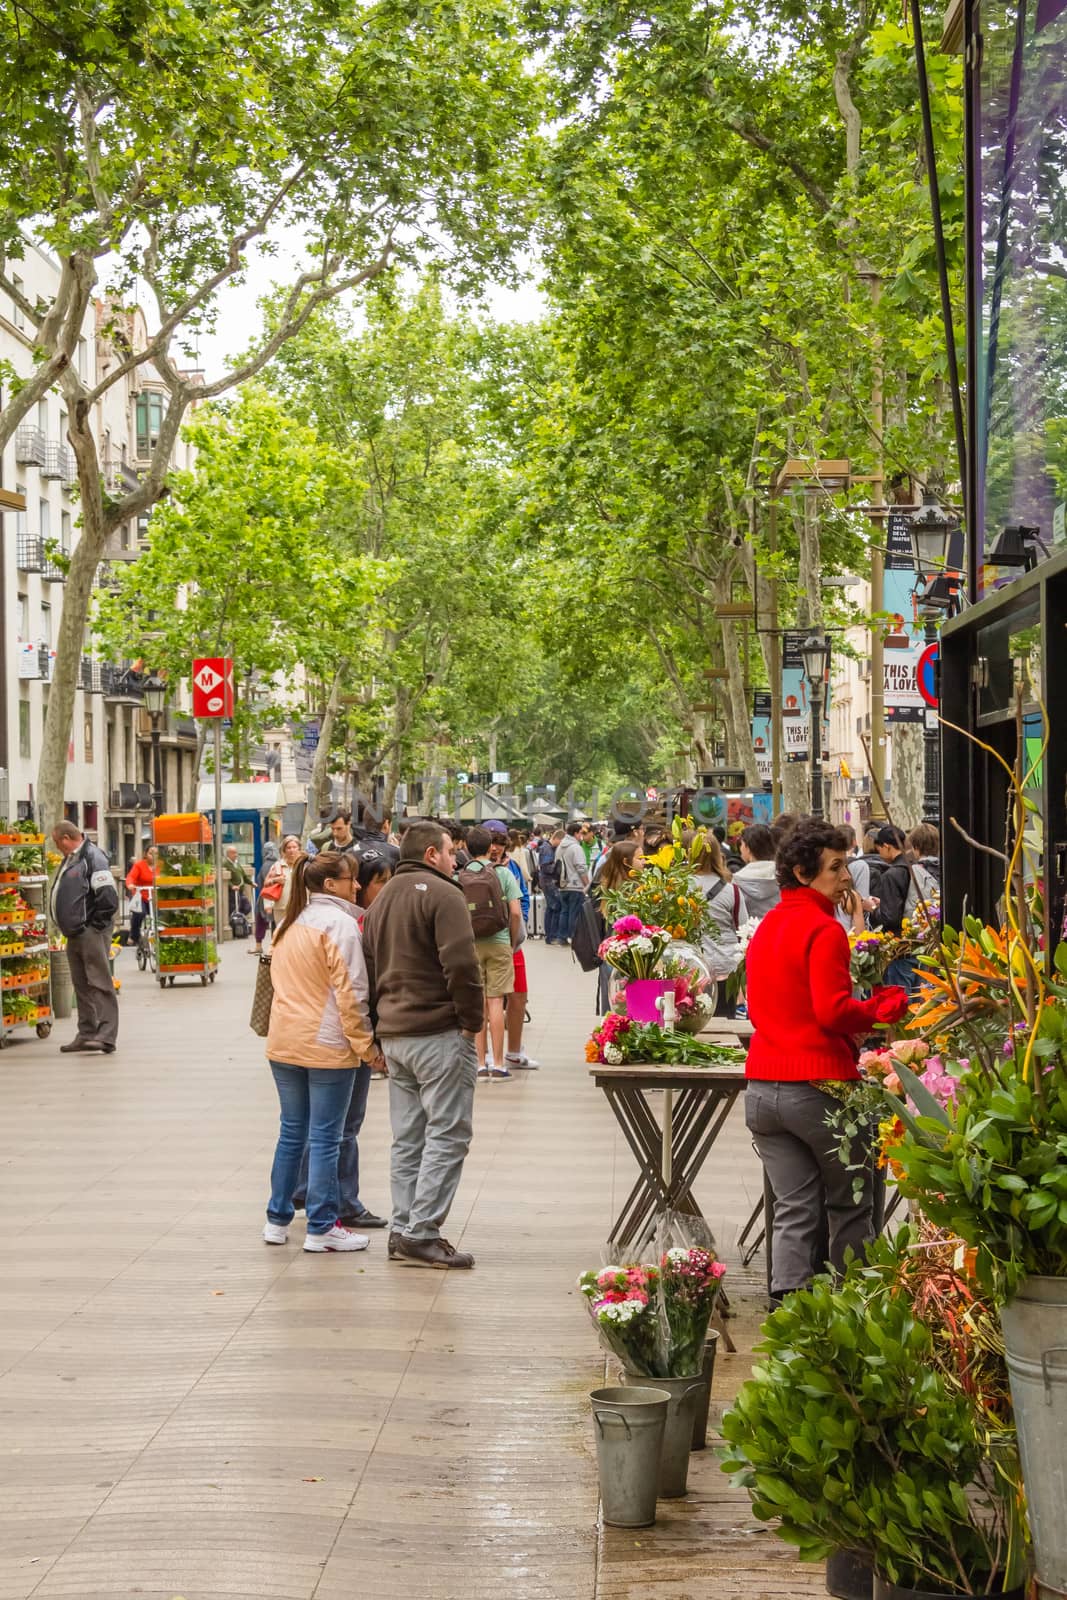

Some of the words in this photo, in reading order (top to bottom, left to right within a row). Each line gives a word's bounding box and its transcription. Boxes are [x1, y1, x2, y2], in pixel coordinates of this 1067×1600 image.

[884, 664, 909, 678] THIS
[201, 673, 213, 686] M
[883, 679, 889, 690] A
[893, 679, 917, 690] LOVE
[786, 726, 802, 735] THIS
[793, 735, 808, 743] LOVE
